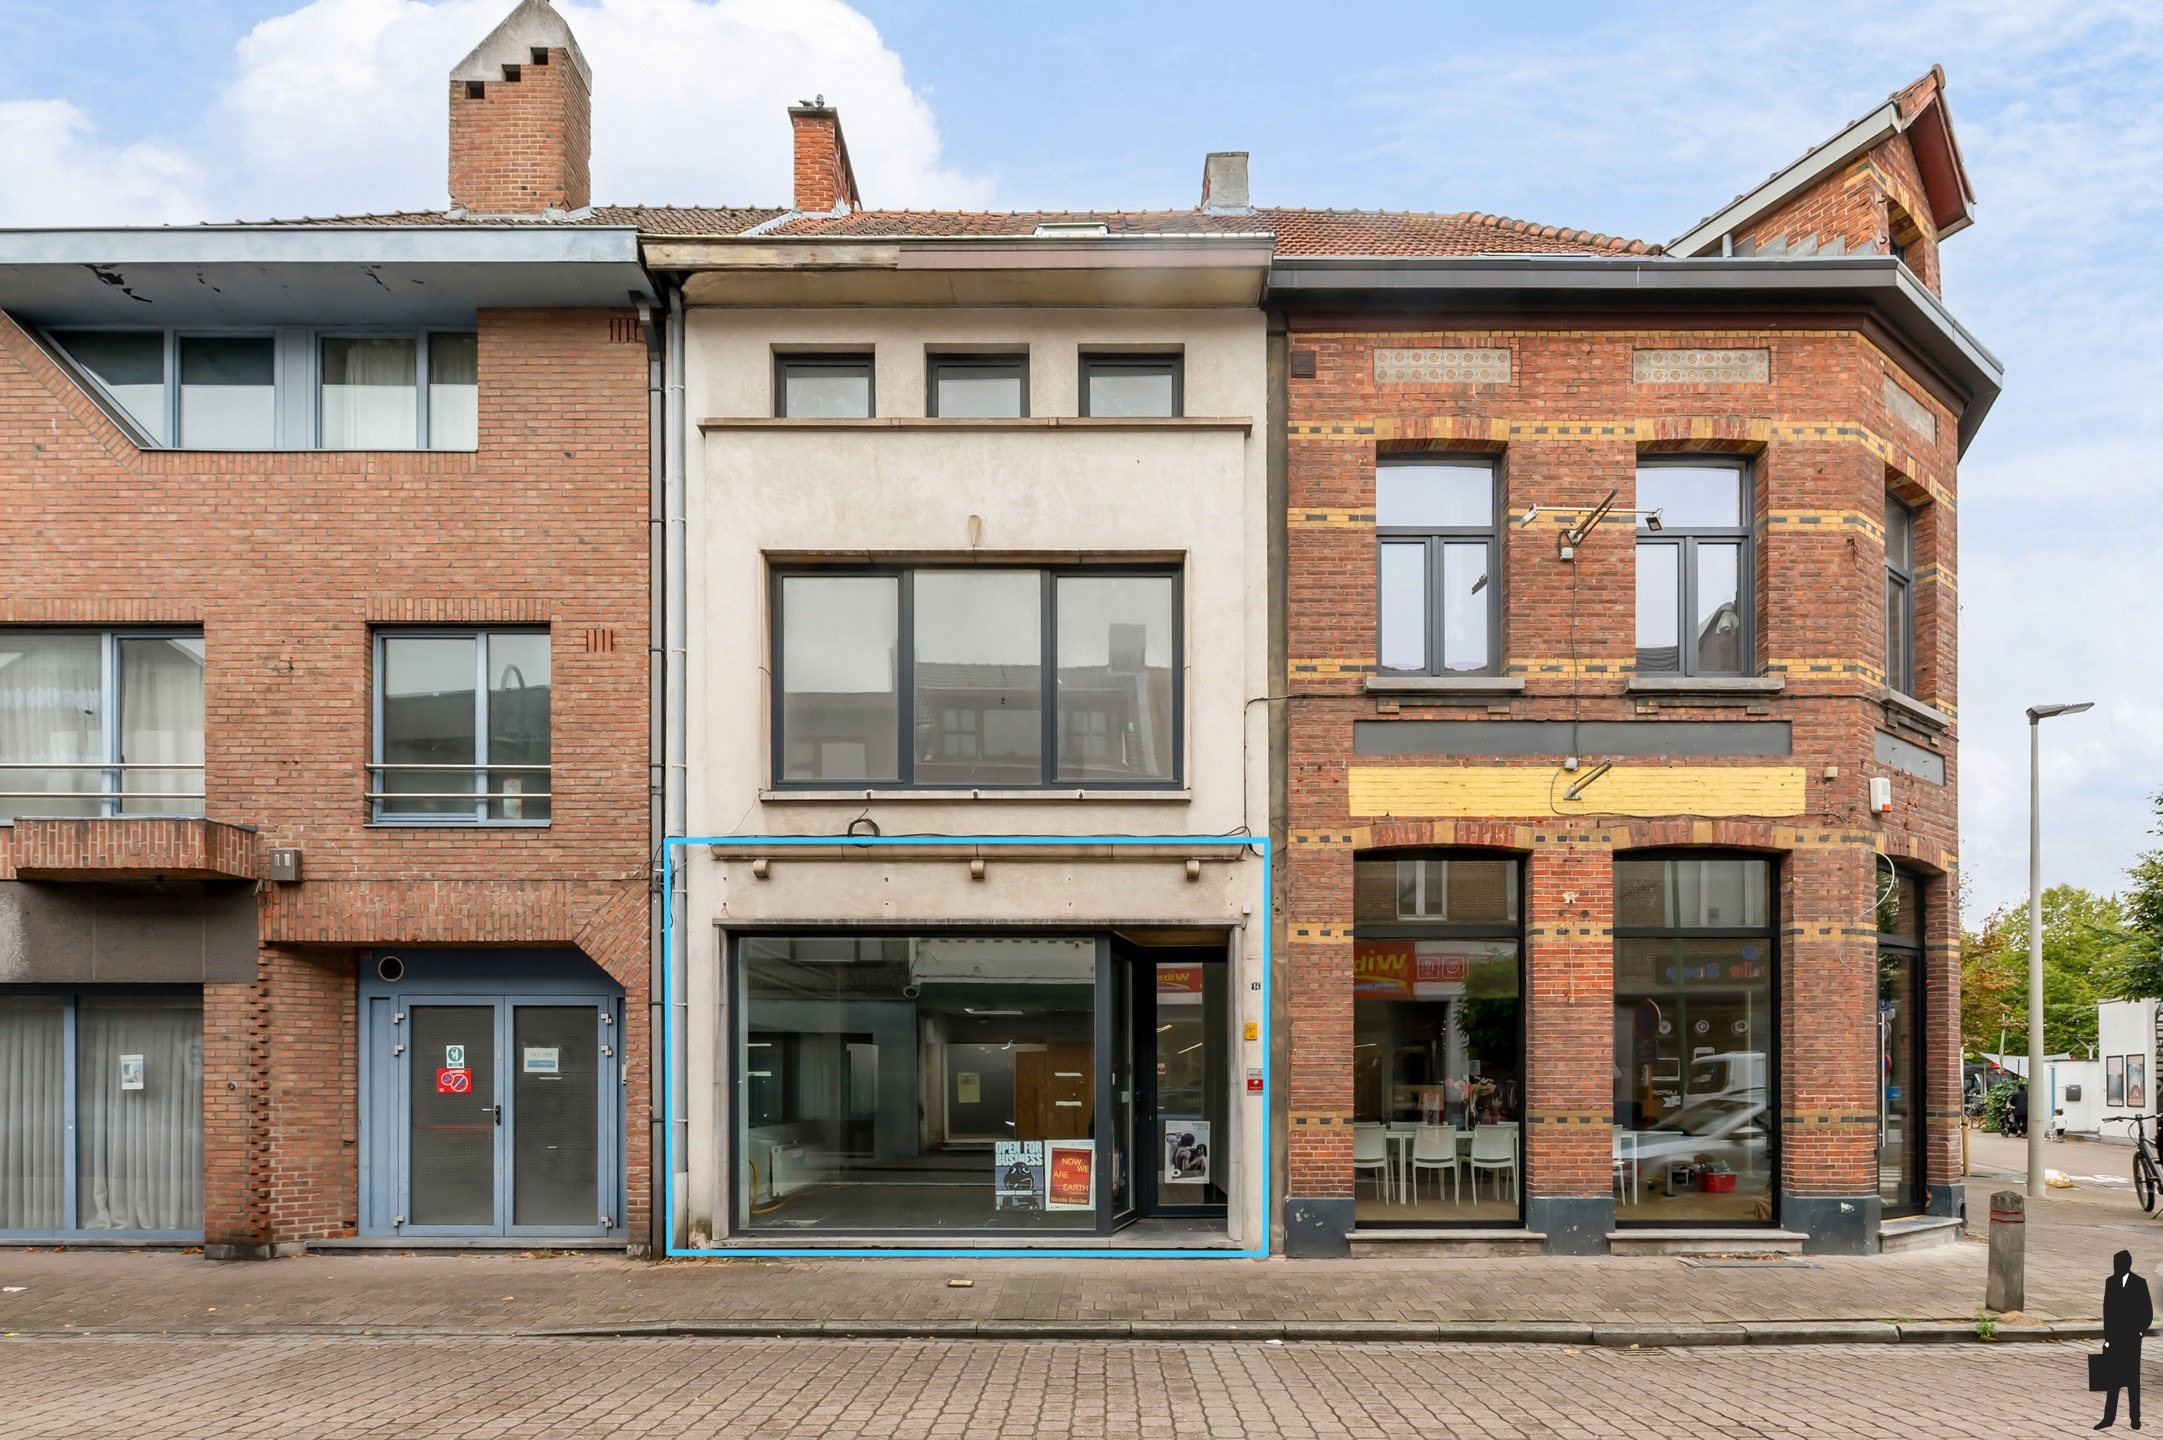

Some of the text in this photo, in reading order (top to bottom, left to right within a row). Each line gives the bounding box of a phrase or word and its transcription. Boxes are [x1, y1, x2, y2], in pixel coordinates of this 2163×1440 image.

[995, 1141, 1043, 1154] OPEN FOR
[995, 1153, 1043, 1166] BUSINESS
[1061, 1157, 1082, 1166] NOW
[1076, 1165, 1089, 1173] WE
[1053, 1171, 1069, 1179] ARE
[1062, 1183, 1089, 1192] EARTH
[1050, 1196, 1068, 1204] Nicole
